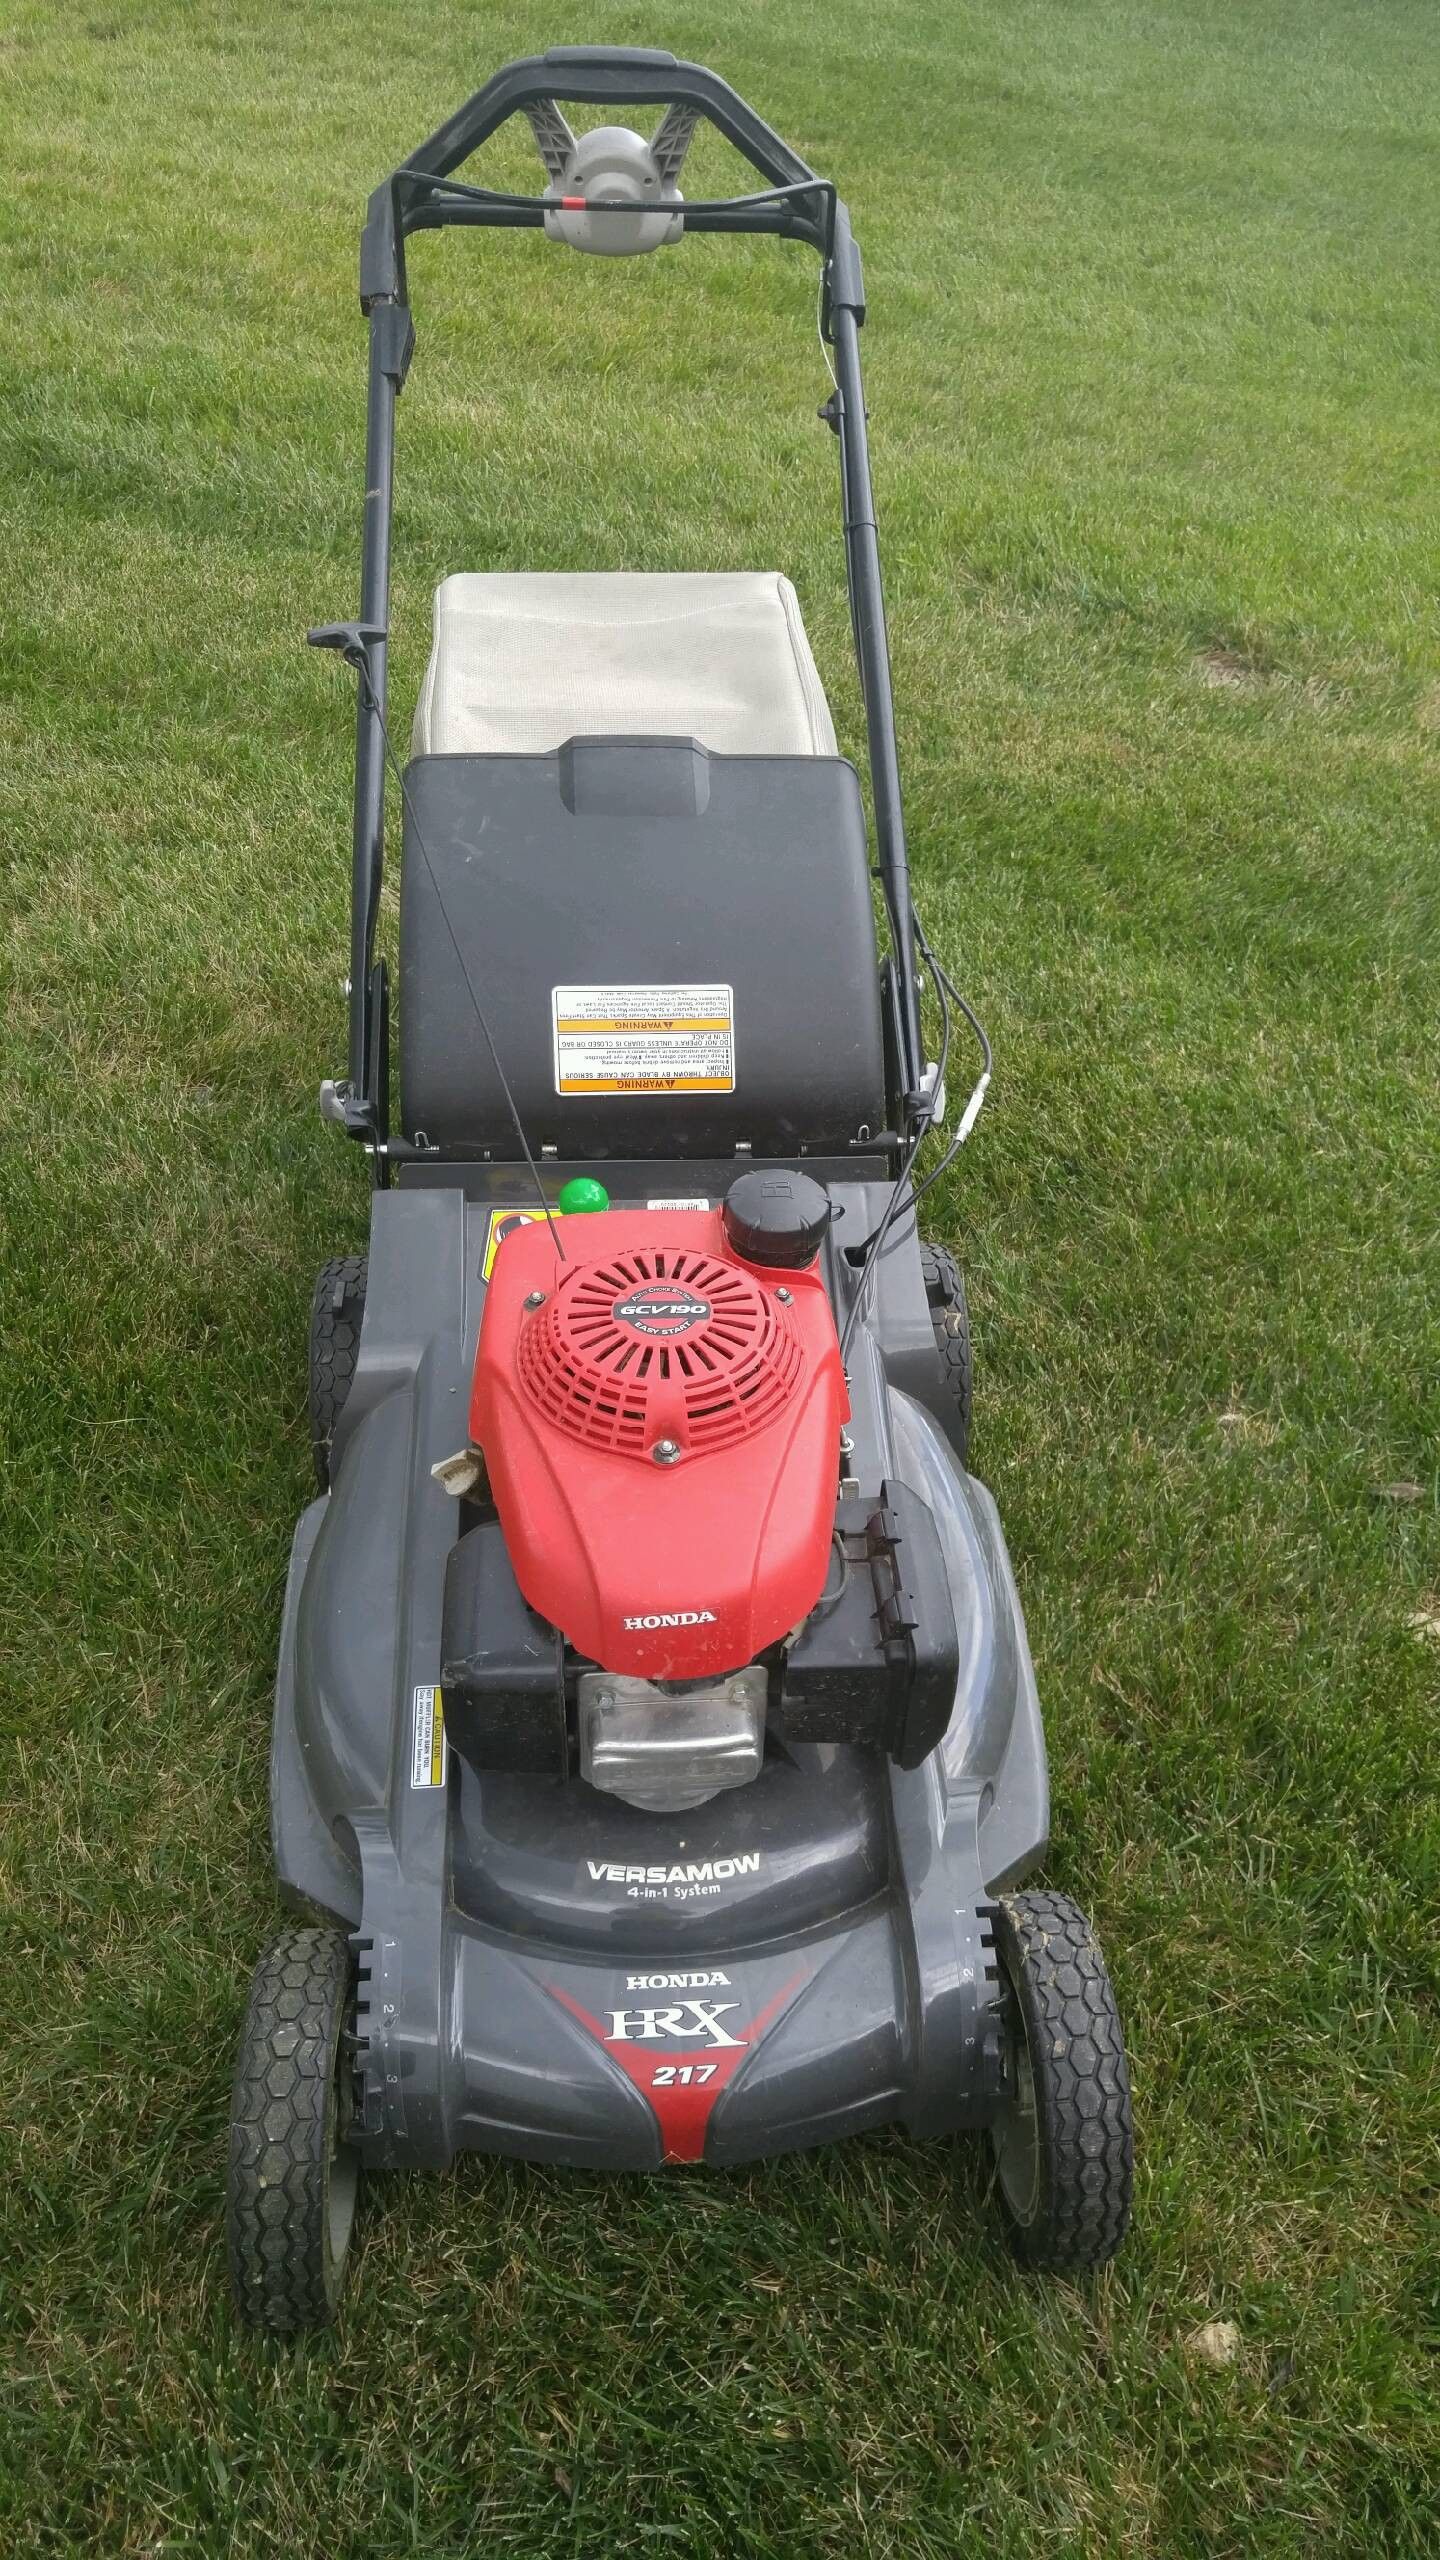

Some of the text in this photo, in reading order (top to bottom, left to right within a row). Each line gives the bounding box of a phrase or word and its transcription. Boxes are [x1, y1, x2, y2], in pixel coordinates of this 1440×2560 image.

[617, 1080, 664, 1088] WARNING
[621, 1305, 706, 1315] GCV190
[634, 1321, 691, 1335] EASY START
[624, 1611, 717, 1630] HONDA
[586, 1852, 760, 1883] VERSAMOW
[627, 1883, 721, 1900] 4-in-1 System
[963, 1967, 974, 1977] 2
[626, 1971, 731, 1990] HONDA
[383, 2004, 395, 2014] 2
[603, 1999, 749, 2048] HRX
[965, 2037, 975, 2045] 3
[652, 2064, 719, 2087] 217
